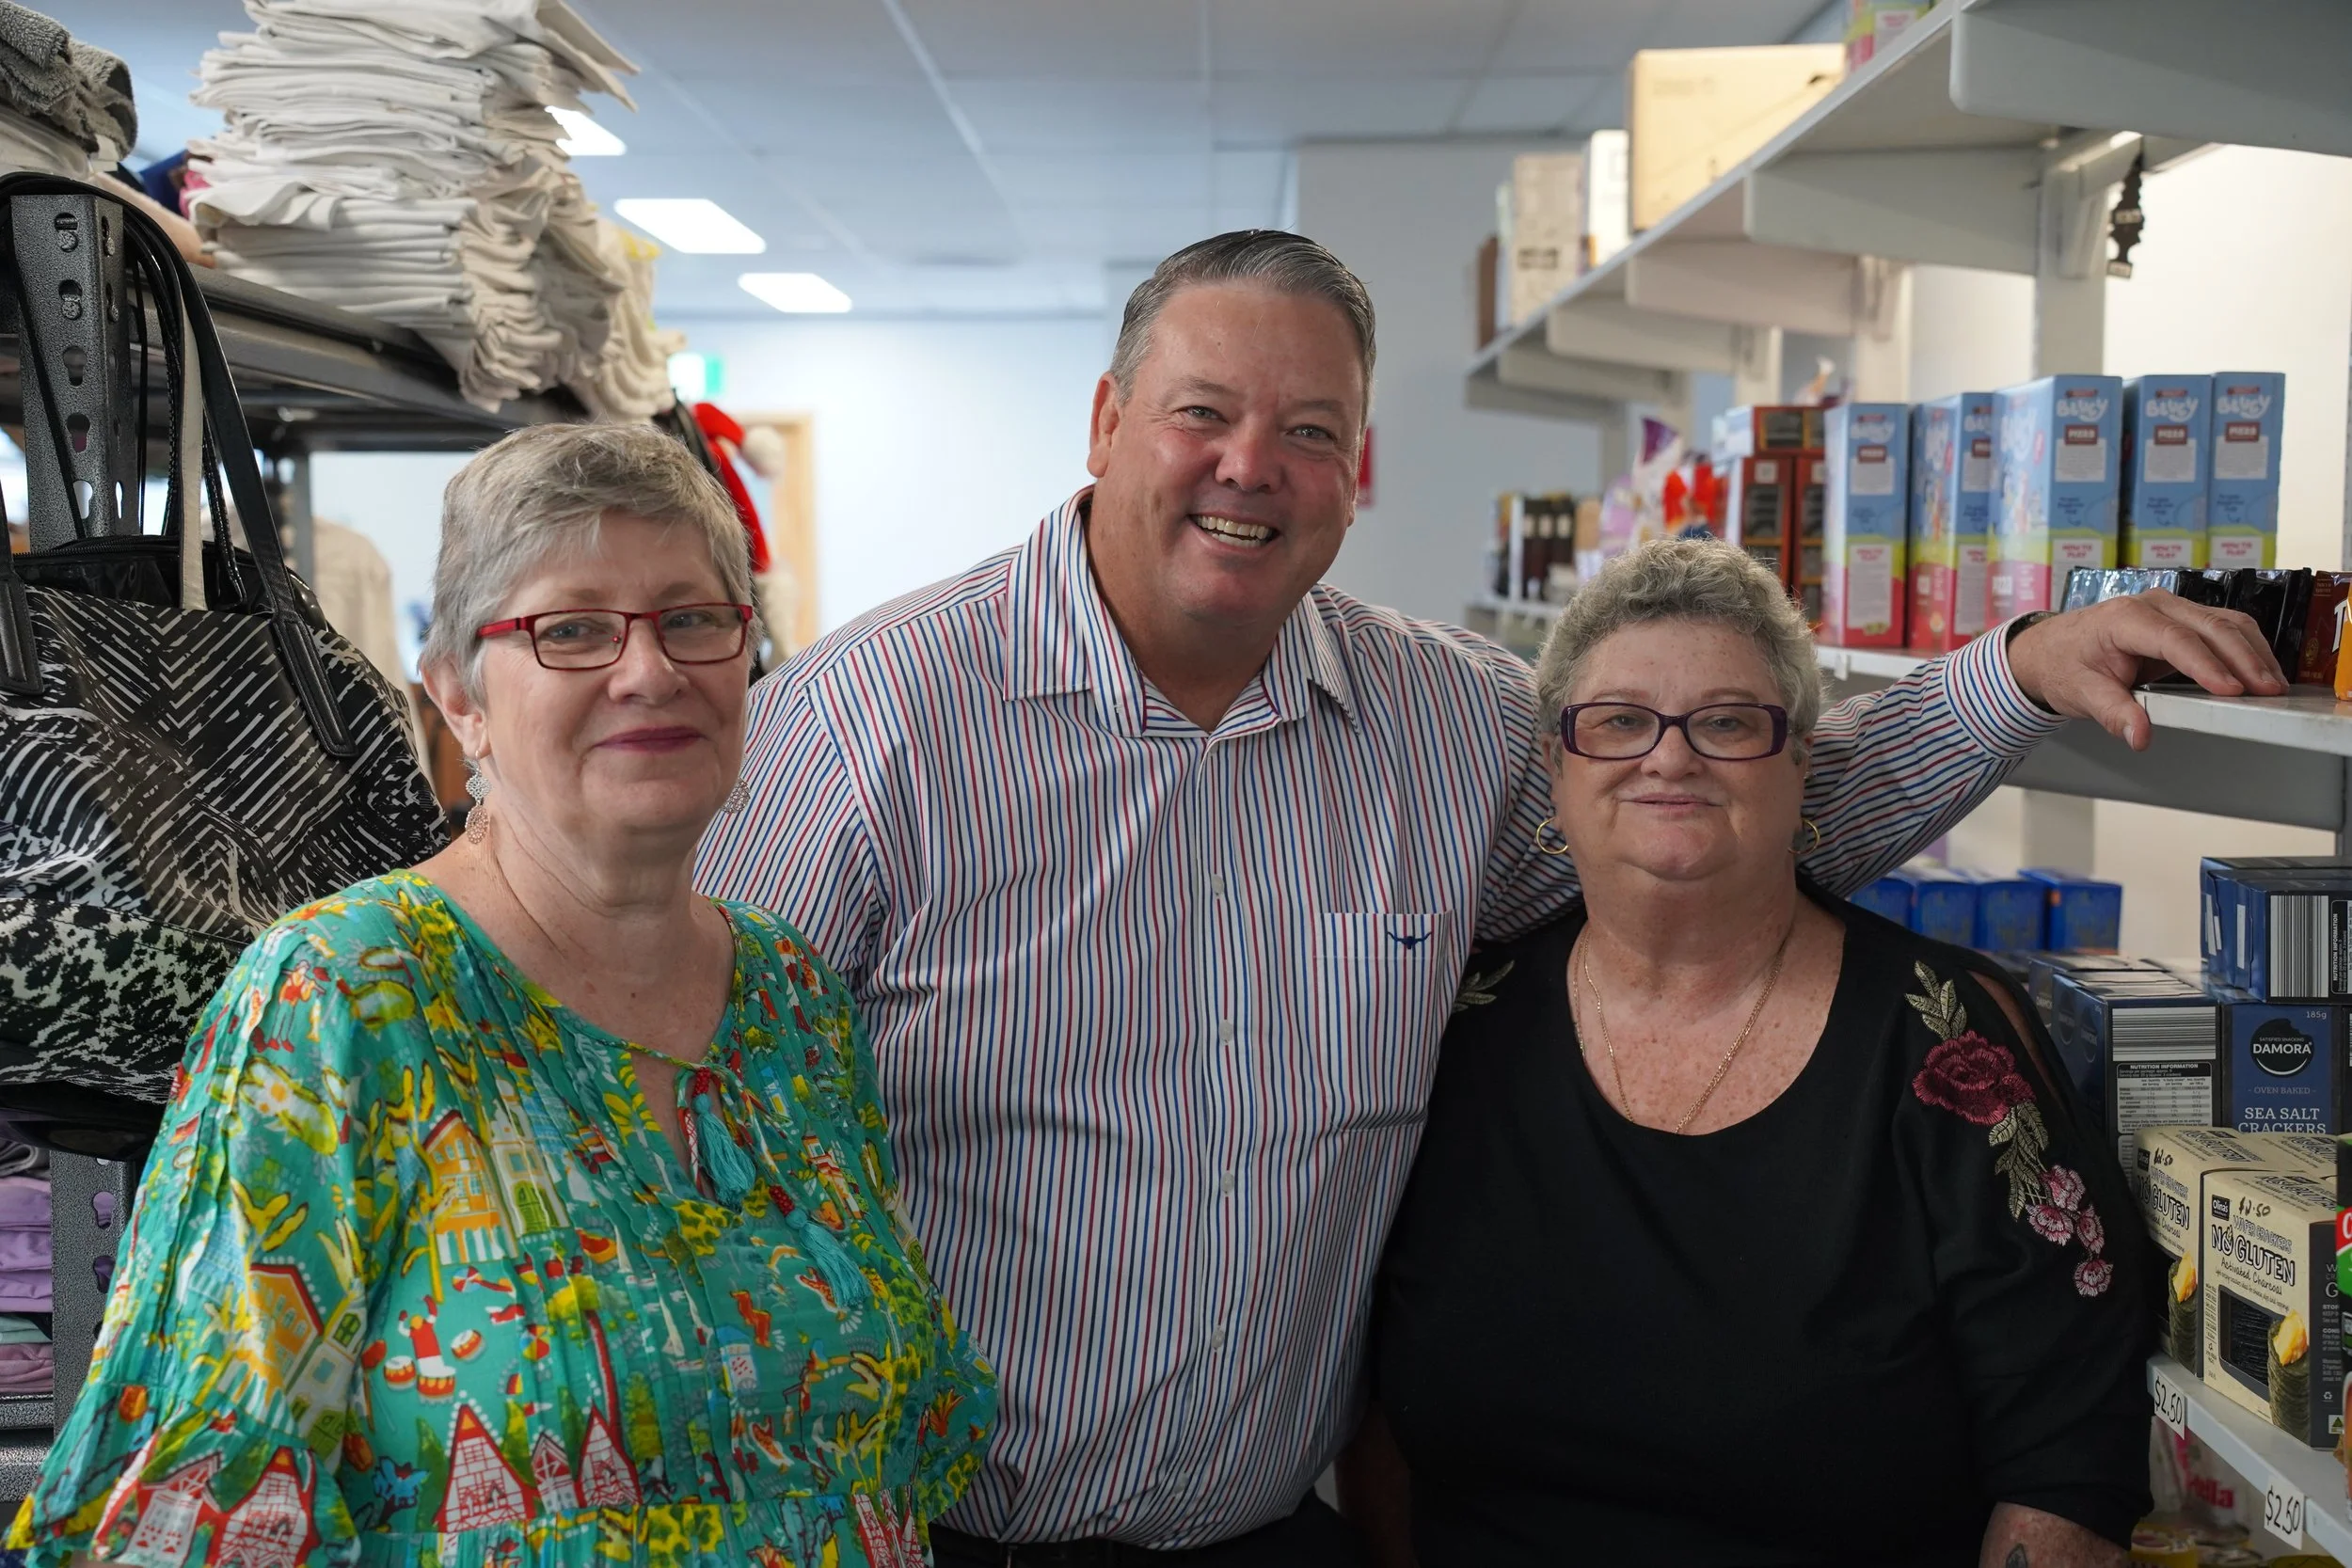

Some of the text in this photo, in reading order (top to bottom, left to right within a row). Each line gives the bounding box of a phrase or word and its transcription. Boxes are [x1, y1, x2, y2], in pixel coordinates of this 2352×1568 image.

[2306, 1011, 2327, 1020] 185g
[2253, 1043, 2312, 1054] DAMORA
[2281, 1086, 2311, 1095] BAKED
[2245, 1107, 2320, 1119] SEA SALT
[2238, 1122, 2327, 1134] CRACKERS
[2151, 1184, 2190, 1230] GLUTEN
[2213, 1198, 2229, 1213] Olina's
[2233, 1215, 2293, 1255] WAFER CRACKERS
[2212, 1224, 2296, 1287] NO GLUTEN
[2221, 1258, 2282, 1296] Activated Charcoal
[2153, 1375, 2183, 1426] $2.50
[2265, 1485, 2302, 1535] $2.50
